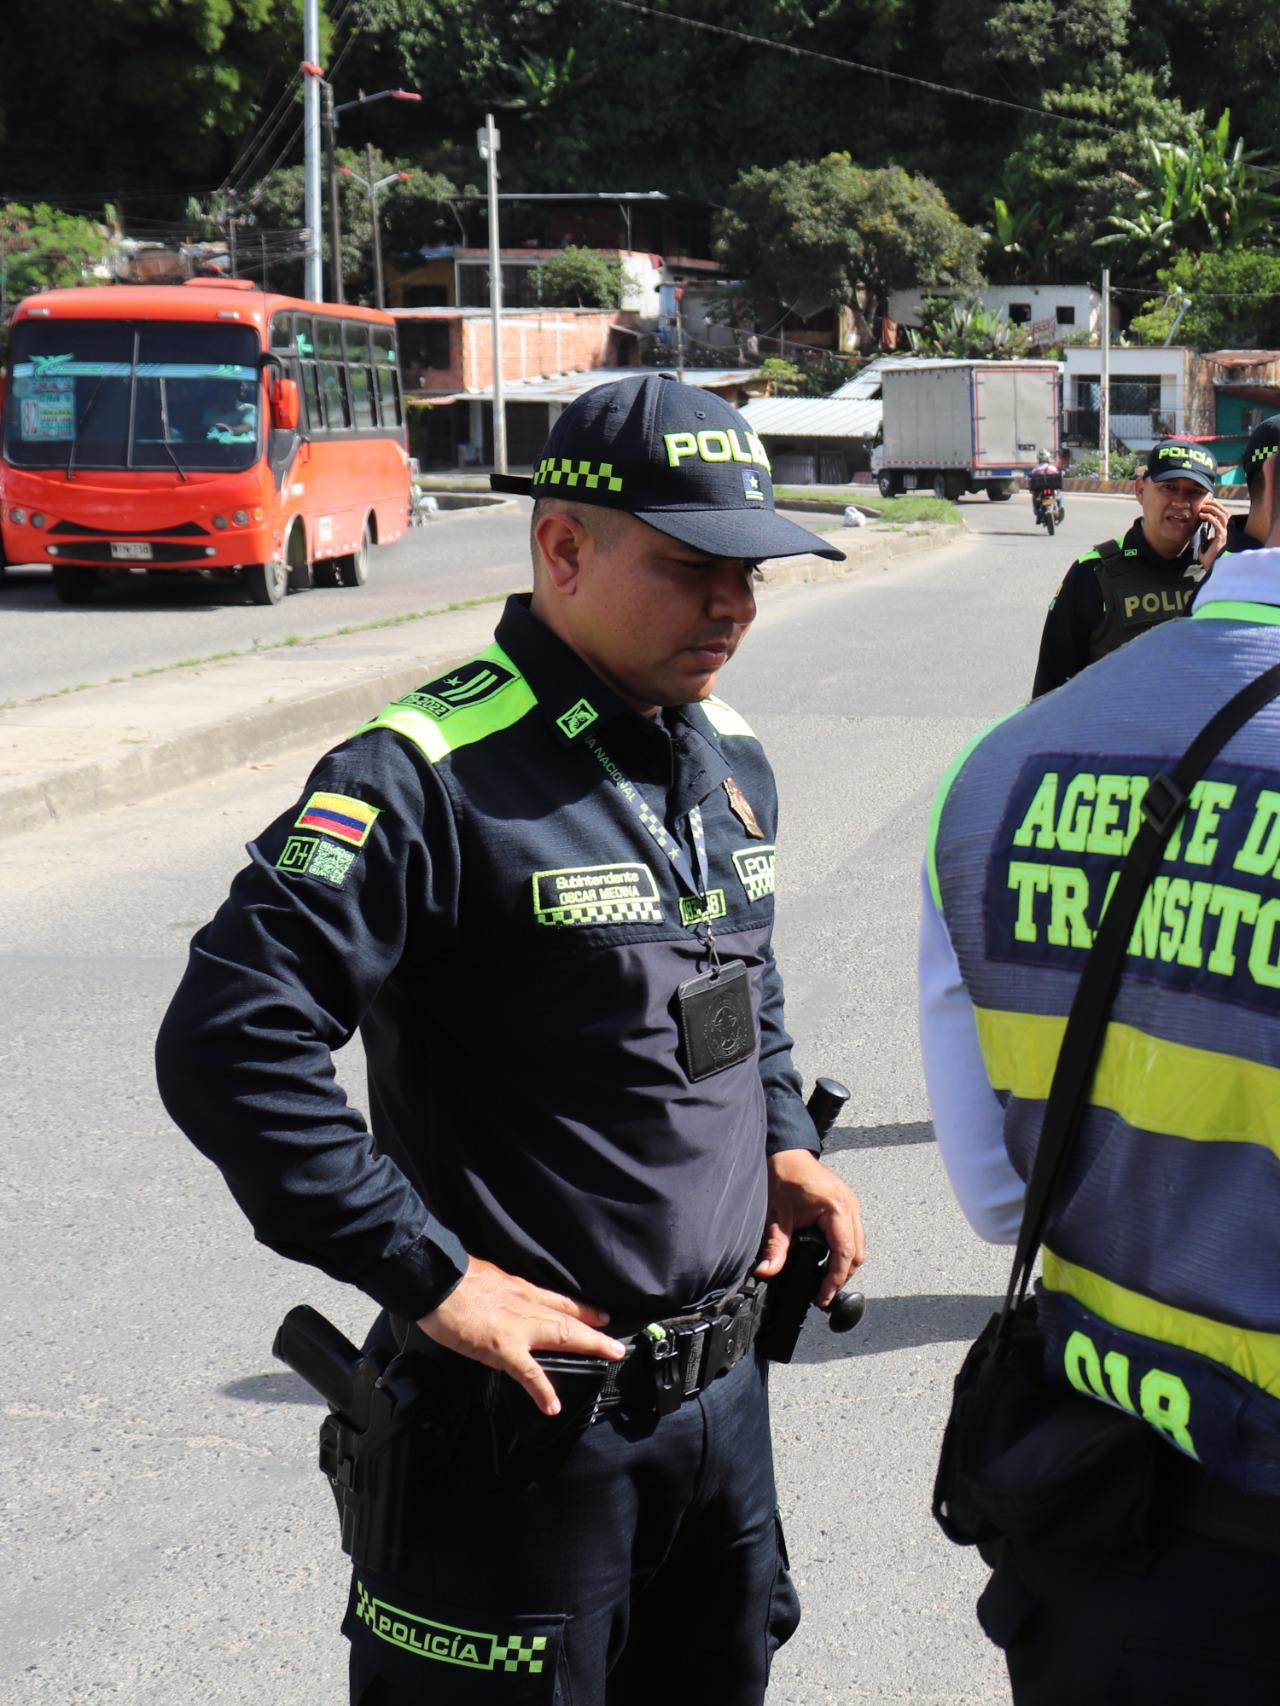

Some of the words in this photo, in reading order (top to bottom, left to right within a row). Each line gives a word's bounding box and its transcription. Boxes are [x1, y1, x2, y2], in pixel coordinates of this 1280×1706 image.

[594, 746, 636, 802] NACIONAL
[556, 872, 639, 889] Subintendente
[560, 889, 597, 905] OSCAR
[599, 885, 640, 901] MEDINA
[378, 1614, 480, 1663] POLICÍA
